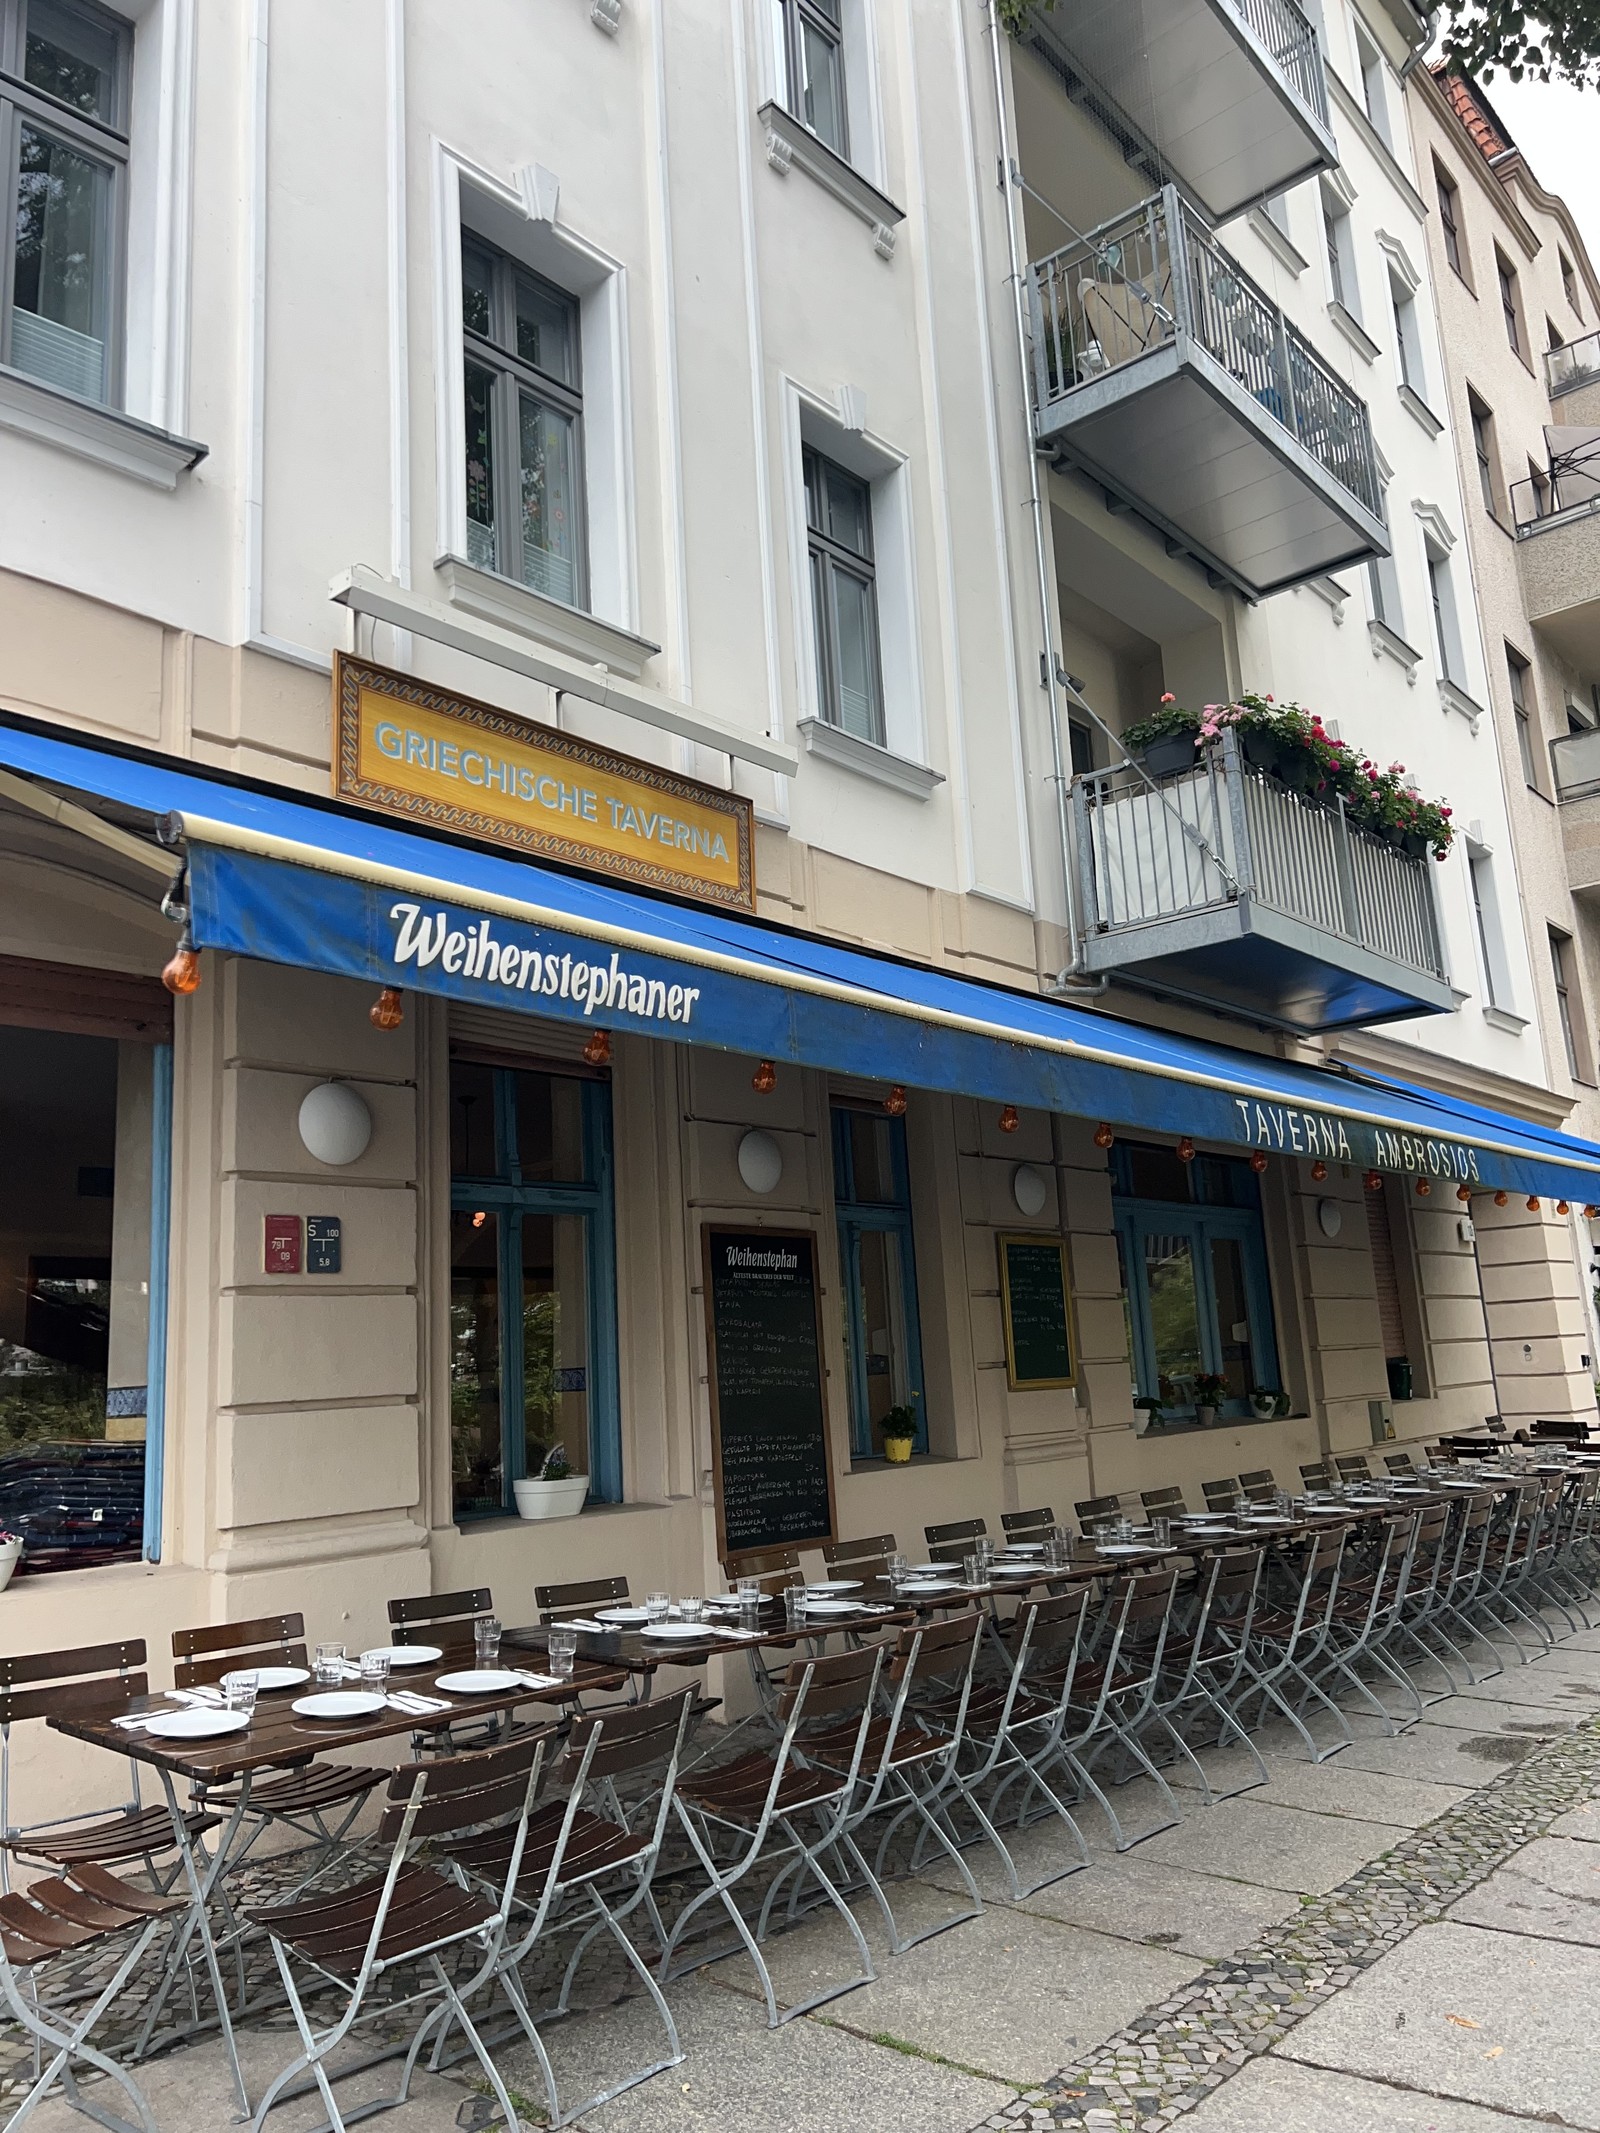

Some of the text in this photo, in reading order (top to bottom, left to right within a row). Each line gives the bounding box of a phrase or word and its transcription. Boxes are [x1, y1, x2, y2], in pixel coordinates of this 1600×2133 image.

[374, 721, 730, 864] GRIECHISCHE TAVERNA
[390, 903, 700, 1024] Weihenstephaner
[1235, 1099, 1480, 1182] TAVERNA AMBROSIOS
[308, 1224, 339, 1237] S 100
[726, 1246, 798, 1271] Weihenstephan
